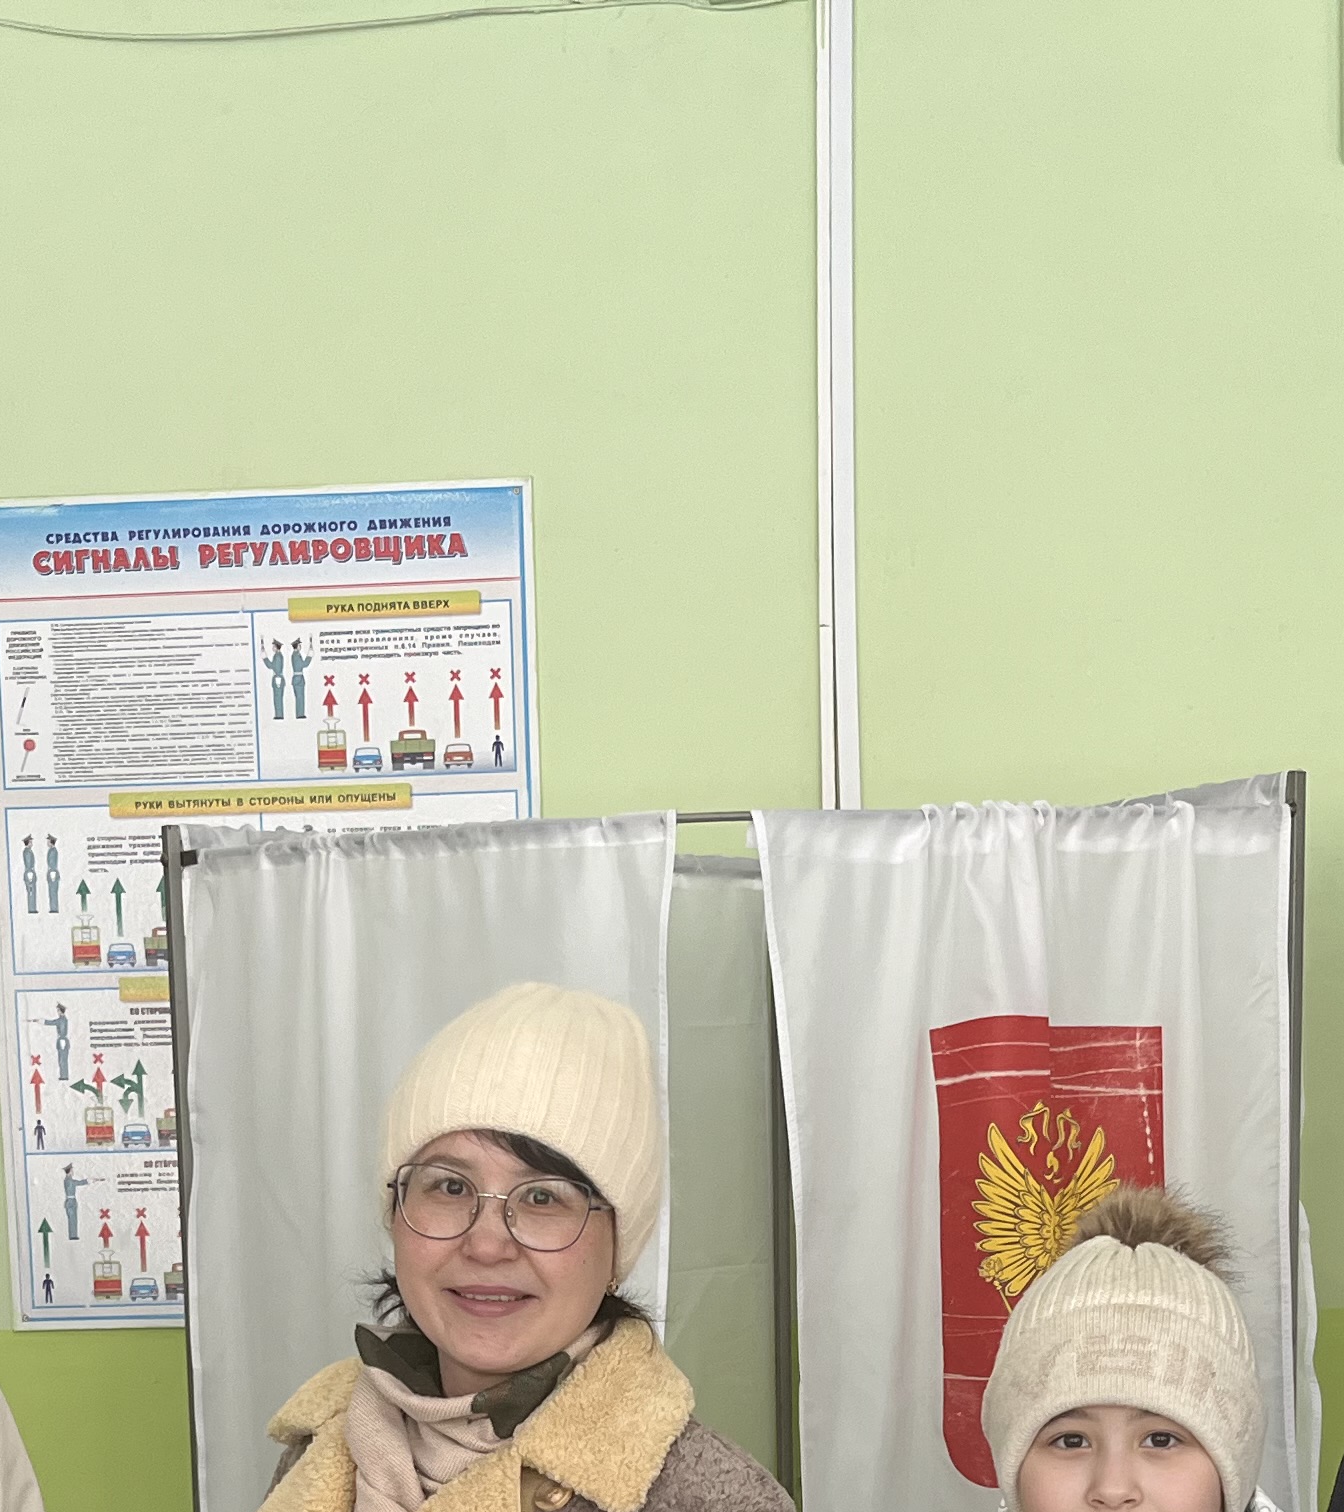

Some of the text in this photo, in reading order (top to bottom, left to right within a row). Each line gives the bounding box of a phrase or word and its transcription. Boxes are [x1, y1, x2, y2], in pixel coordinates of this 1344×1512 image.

[46, 516, 453, 545] СРЕДСТВА РЕГУЛИРОВАНИЯ ДОРОЖНОГО ДВИЖЕНИЯ
[33, 532, 469, 577] СИГНАЛЫ РЕГУЛИРОВЩИКА
[326, 600, 450, 613] РУКА ПОДНЯТА ВВЕРХ
[134, 791, 397, 811] РУКИ ВЫТЯНУТЫ В СТОРОНЫ ИЛИ ОПУЩЕНЫ
